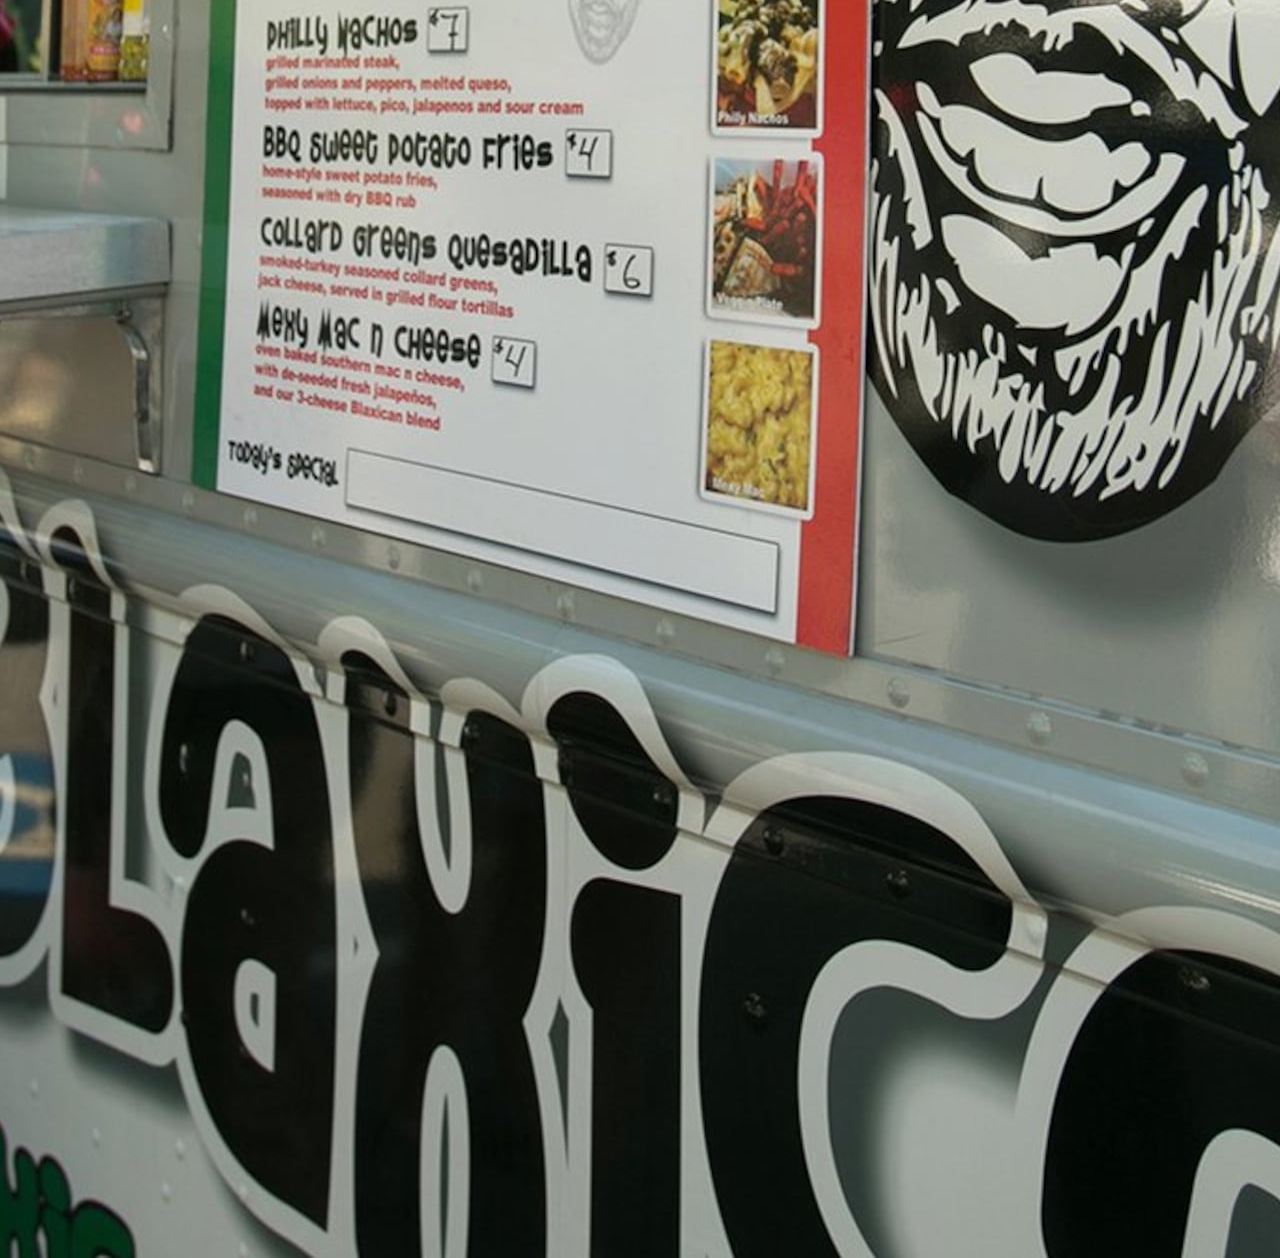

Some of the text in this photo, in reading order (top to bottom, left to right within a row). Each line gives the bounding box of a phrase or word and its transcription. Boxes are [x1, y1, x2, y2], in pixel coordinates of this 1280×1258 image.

[264, 76, 299, 92] grilled
[301, 76, 338, 90] onions
[340, 76, 362, 90] and
[420, 75, 465, 90] melted
[264, 97, 302, 112] topped
[304, 97, 330, 110] with
[476, 98, 502, 114] and
[505, 102, 535, 114] sour
[538, 102, 584, 115] cream
[263, 125, 302, 163] BBQ
[324, 169, 360, 183] sweet
[363, 171, 403, 186] potato
[343, 264, 400, 281] seasoned
[402, 269, 447, 287] collard
[257, 272, 281, 289] jack
[329, 284, 369, 300] served
[371, 286, 383, 301] in
[385, 289, 425, 307] grilled
[461, 298, 514, 318] tortillas
[254, 363, 279, 378] with
[340, 376, 371, 395] fresh
[253, 384, 273, 398] and
[275, 389, 294, 401] our
[350, 399, 403, 423] Blaxican
[405, 410, 441, 431] blend
